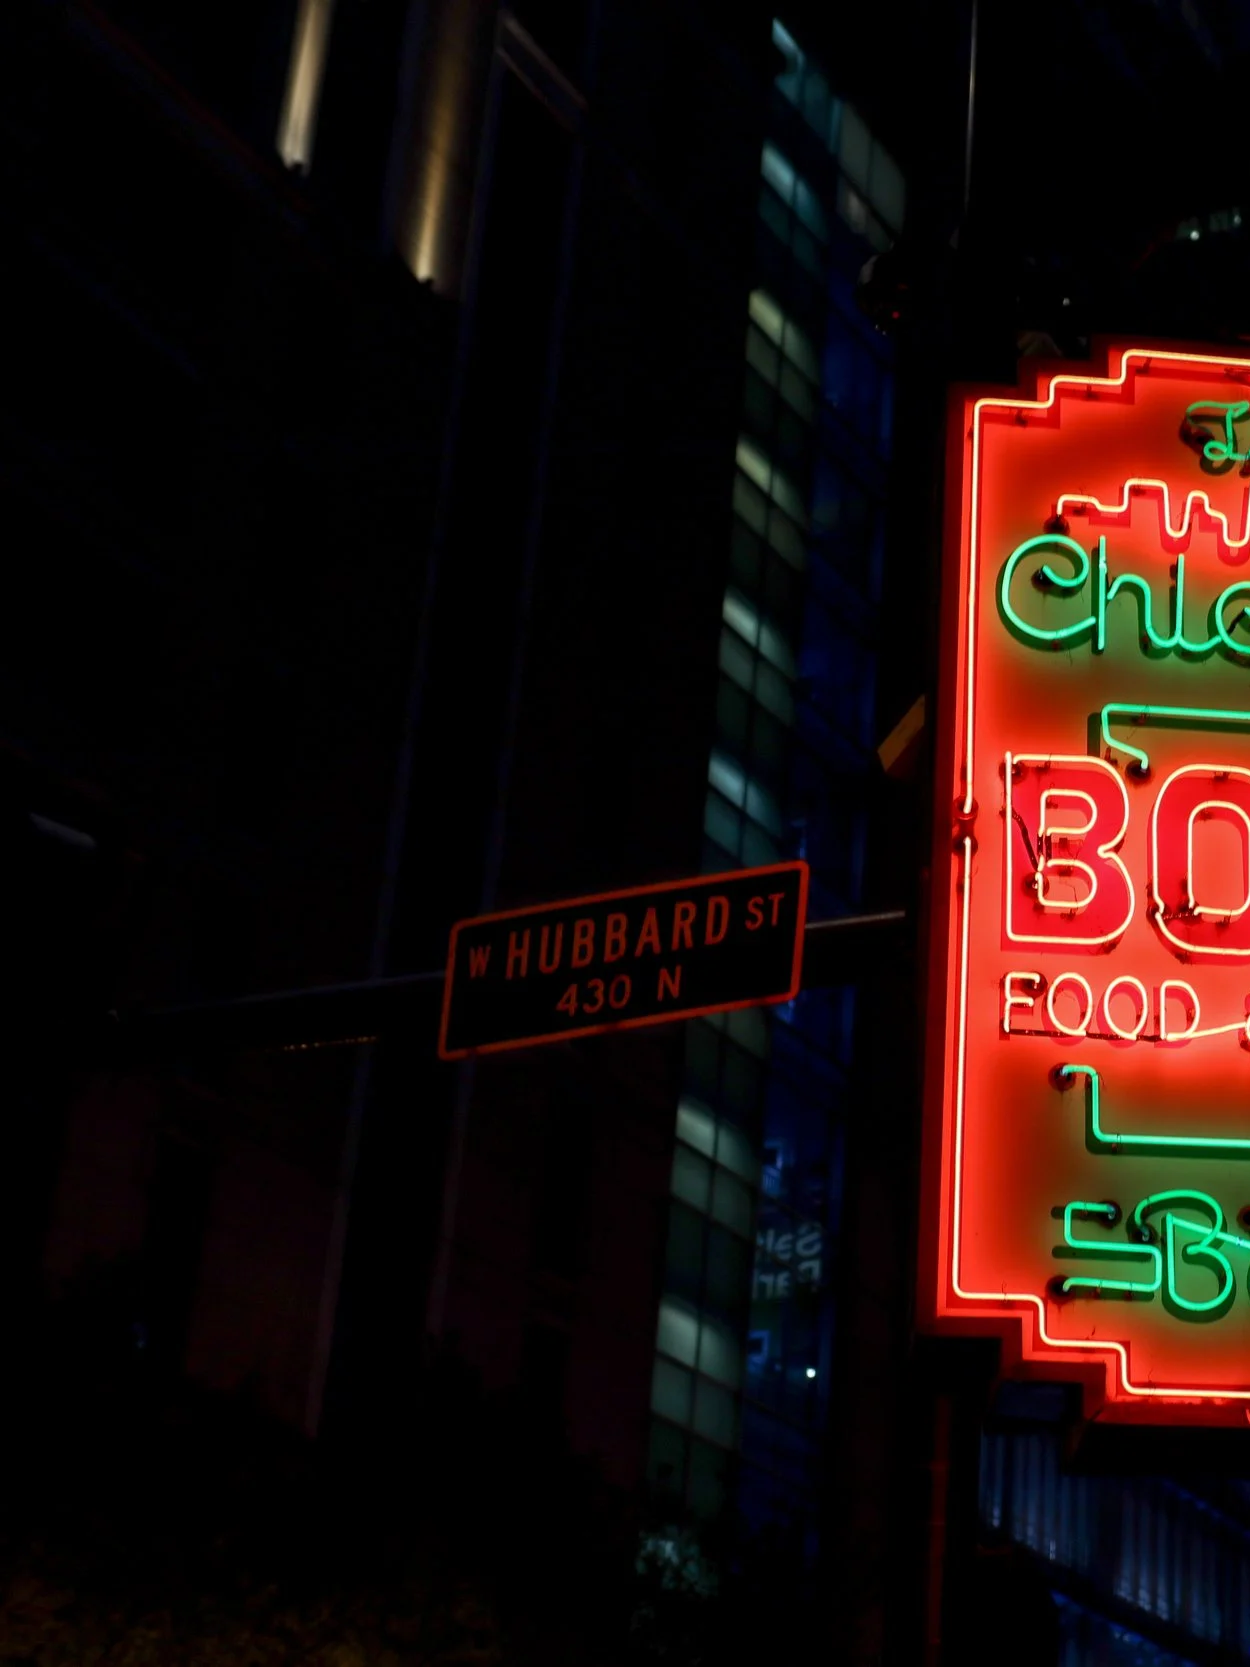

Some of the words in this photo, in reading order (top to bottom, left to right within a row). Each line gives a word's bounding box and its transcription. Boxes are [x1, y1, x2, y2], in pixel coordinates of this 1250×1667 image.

[468, 943, 492, 981] W
[504, 895, 731, 982] HUBBARD
[744, 892, 785, 932] ST
[555, 973, 633, 1018] 430
[656, 963, 682, 1002] N
[1003, 972, 1201, 1042] FOOD
